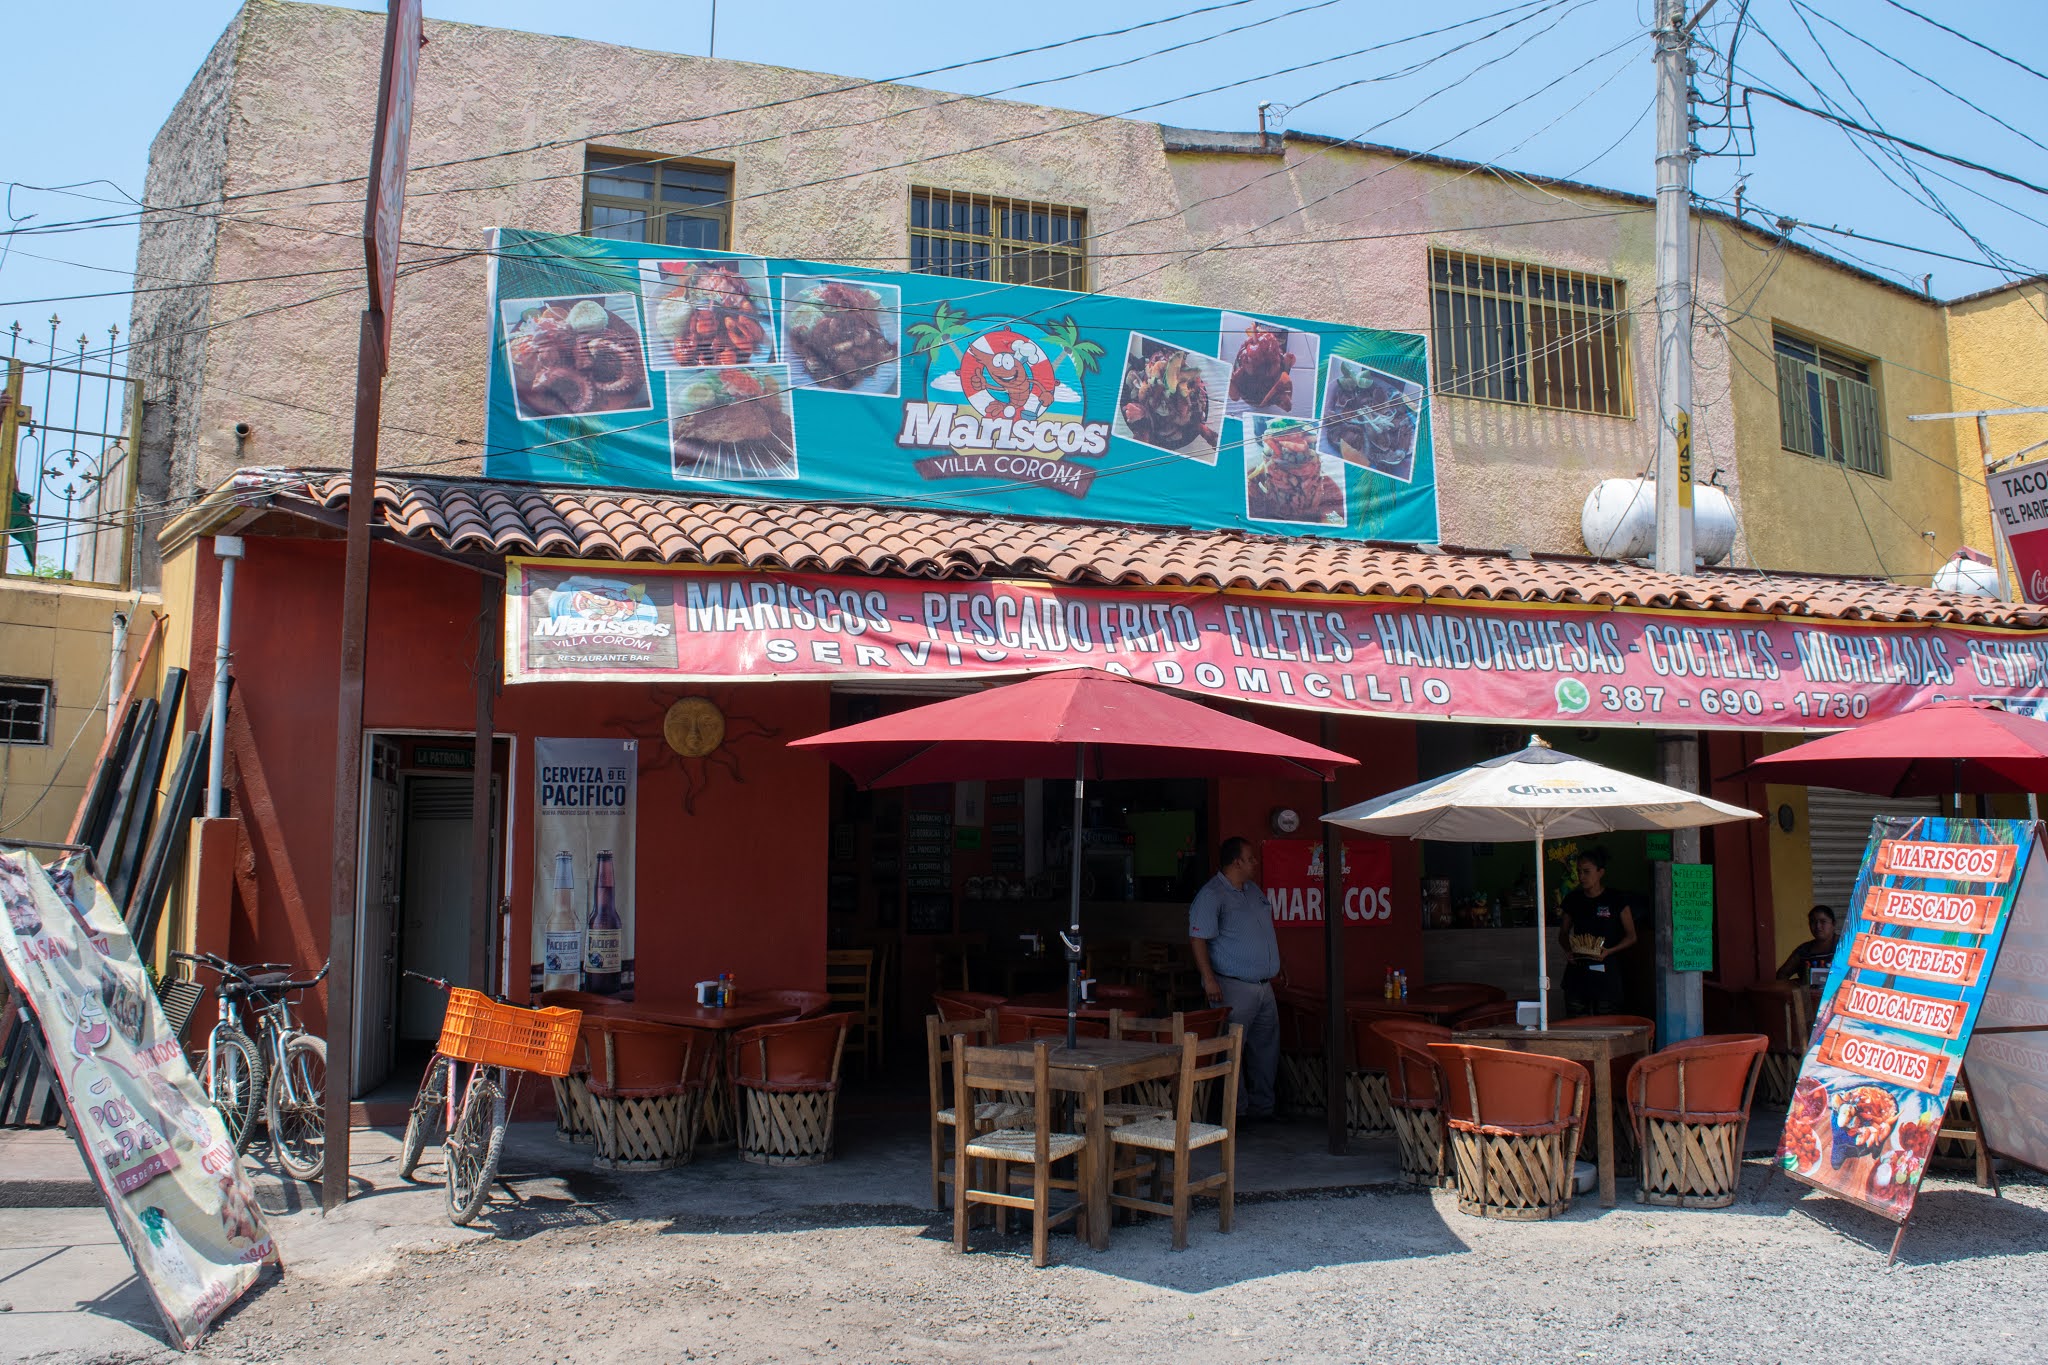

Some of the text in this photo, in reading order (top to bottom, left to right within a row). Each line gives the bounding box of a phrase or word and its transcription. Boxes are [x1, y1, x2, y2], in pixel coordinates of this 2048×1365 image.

[898, 402, 1109, 454] Mariscos
[934, 455, 1083, 490] VILLA CORONA
[2002, 470, 2048, 498] TACO
[533, 615, 671, 637] Mariscos
[684, 580, 893, 636] MARISCOS
[924, 589, 1093, 652] PESCADO
[1100, 601, 1202, 653] FRITO
[1223, 603, 1354, 663] FILETES
[1373, 612, 1625, 673] HAMBURGUESAS
[1643, 622, 1781, 681] COCTELES
[1795, 629, 1955, 686] MICHELADAS
[1966, 638, 2048, 688] CEVICH
[552, 635, 653, 651] VILLA CORONA
[557, 654, 650, 662] RESTAURANTE BAR
[766, 638, 1067, 667] SERVI
[1152, 659, 1452, 704] DOMICILIO
[1600, 685, 1666, 713] 387
[1700, 686, 1763, 716] 690
[1796, 691, 1870, 720] 1730
[2017, 707, 2035, 717] VISA
[542, 766, 604, 783] CERVEZA
[542, 784, 626, 807] PACIFICO
[1507, 784, 1618, 797] Corona
[1891, 845, 1996, 874] MARISCOS
[1886, 894, 1975, 924] PESCADO
[1868, 941, 1964, 976] COCTELES
[1850, 989, 1953, 1031] MOLCAJETES
[1842, 1040, 1928, 1080] OSTIONES
[120, 1169, 149, 1189] DESDE
